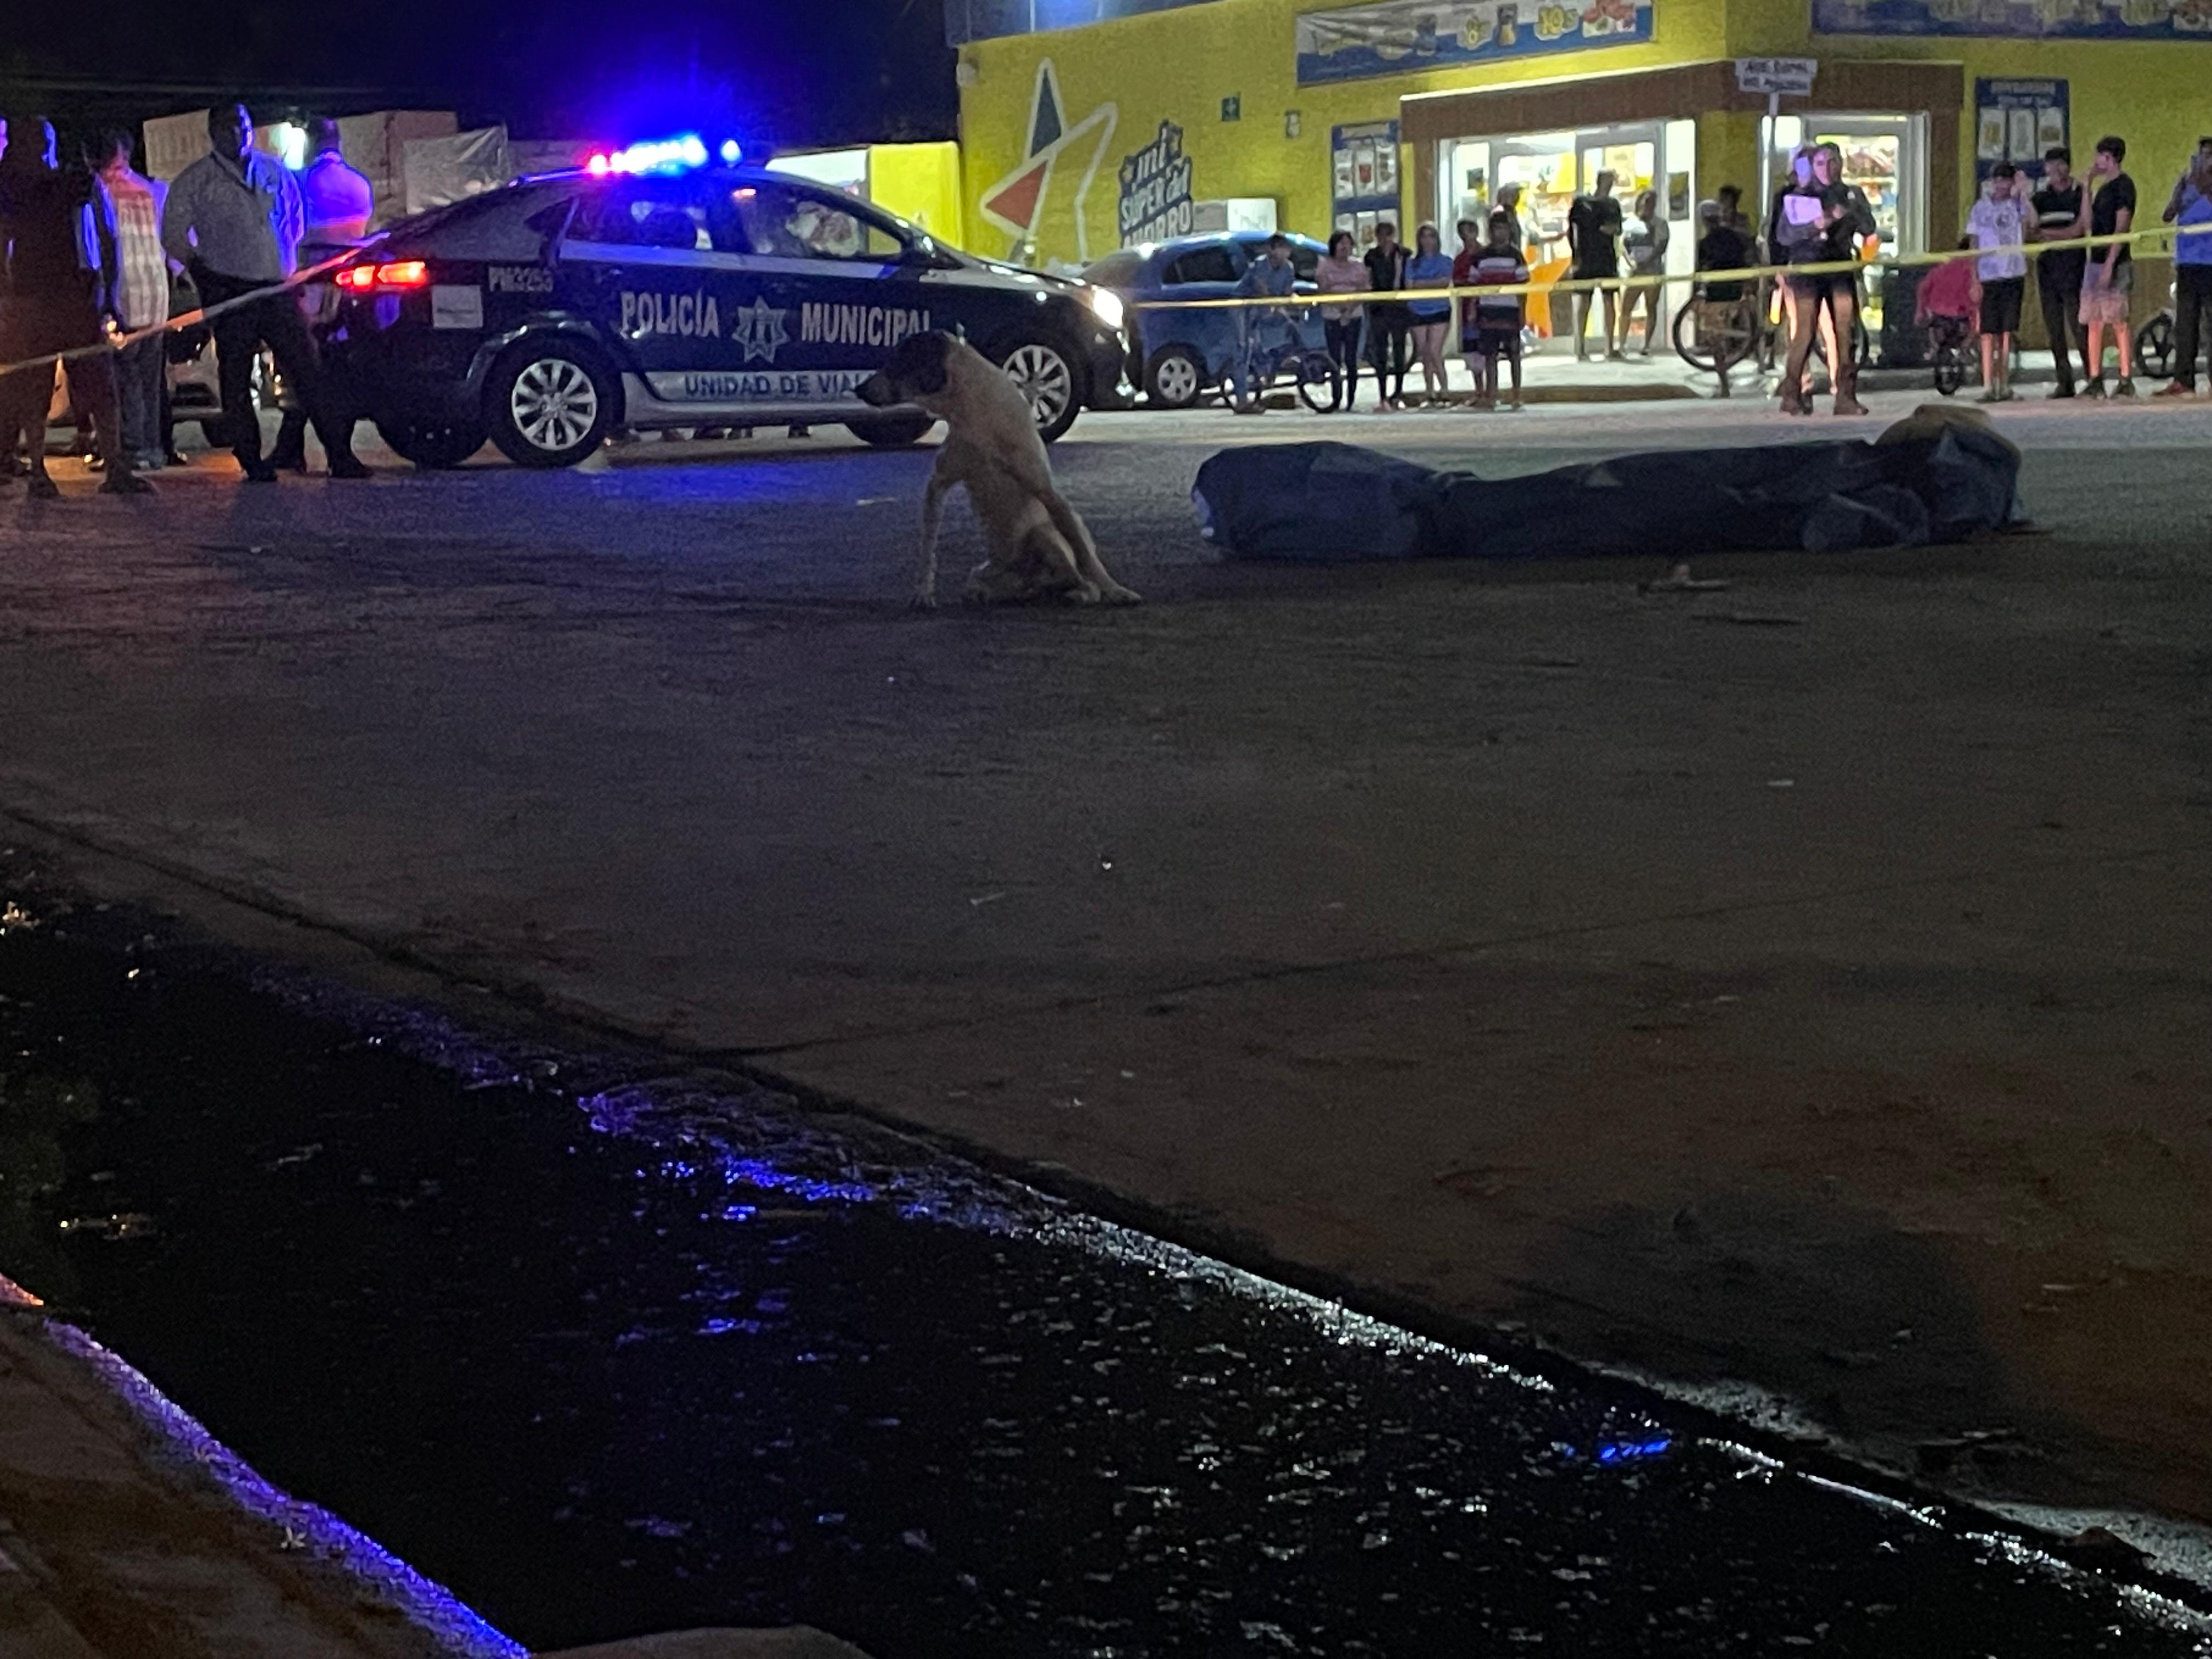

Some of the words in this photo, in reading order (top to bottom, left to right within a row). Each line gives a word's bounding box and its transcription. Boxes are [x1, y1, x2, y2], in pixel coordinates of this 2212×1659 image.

[620, 287, 719, 339] POLICÍA
[685, 375, 770, 396] UNIDAD
[780, 375, 810, 394] DE
